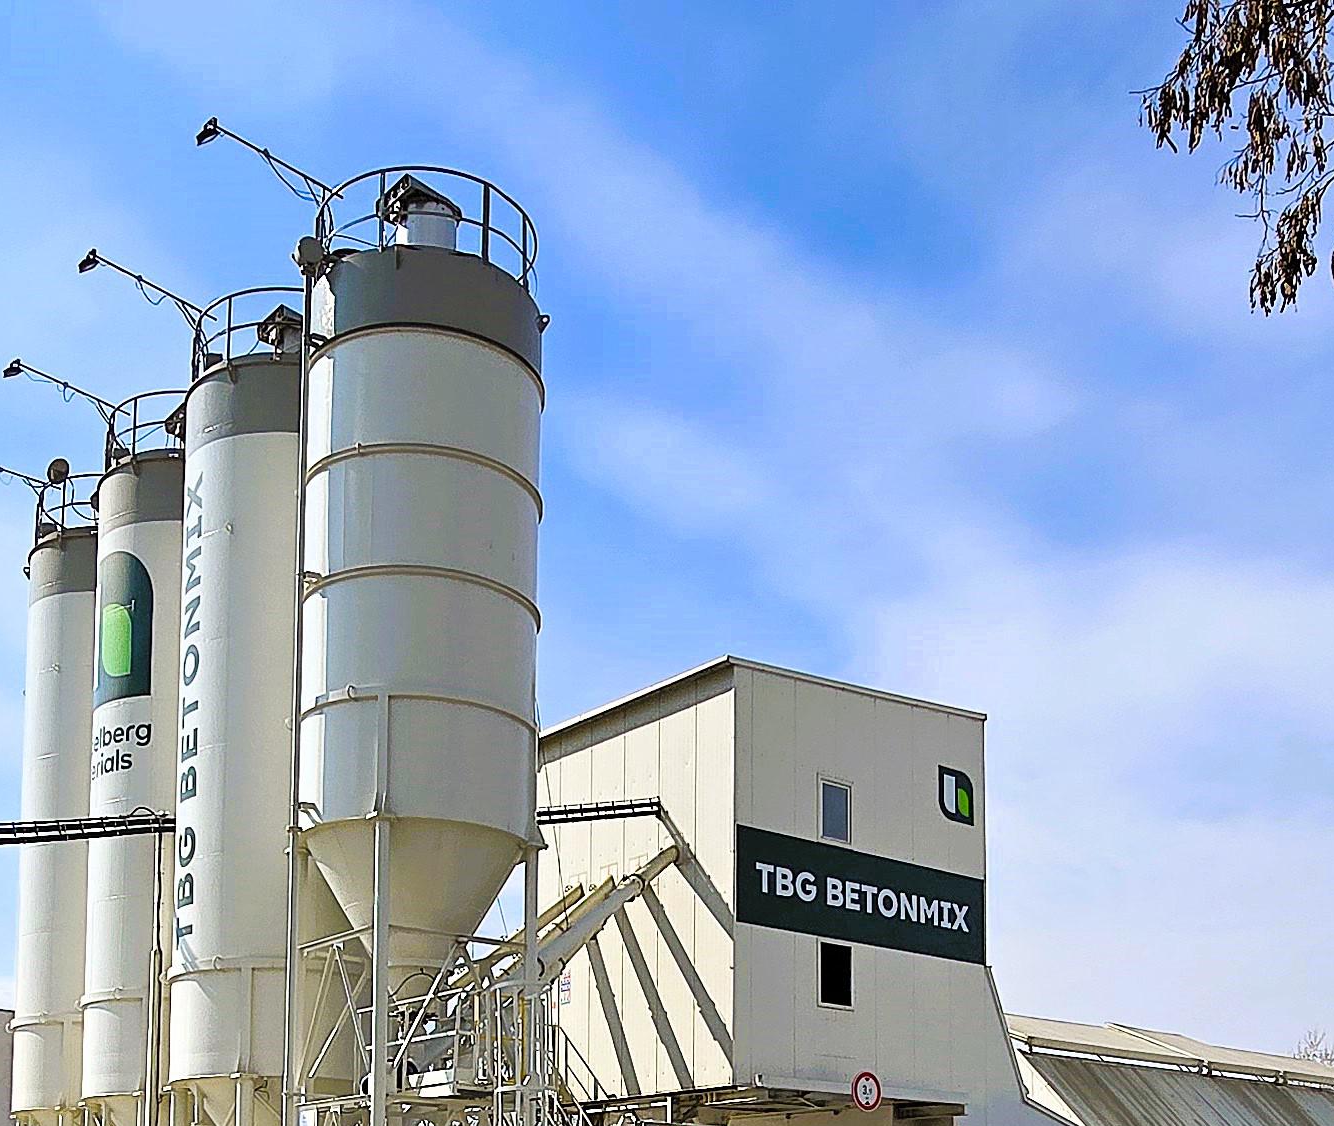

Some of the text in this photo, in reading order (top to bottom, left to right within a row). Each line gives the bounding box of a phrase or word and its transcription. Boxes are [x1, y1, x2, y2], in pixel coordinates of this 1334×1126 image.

[175, 471, 204, 950] TBG BETONMIX
[755, 862, 969, 933] TBG BETONMIX
